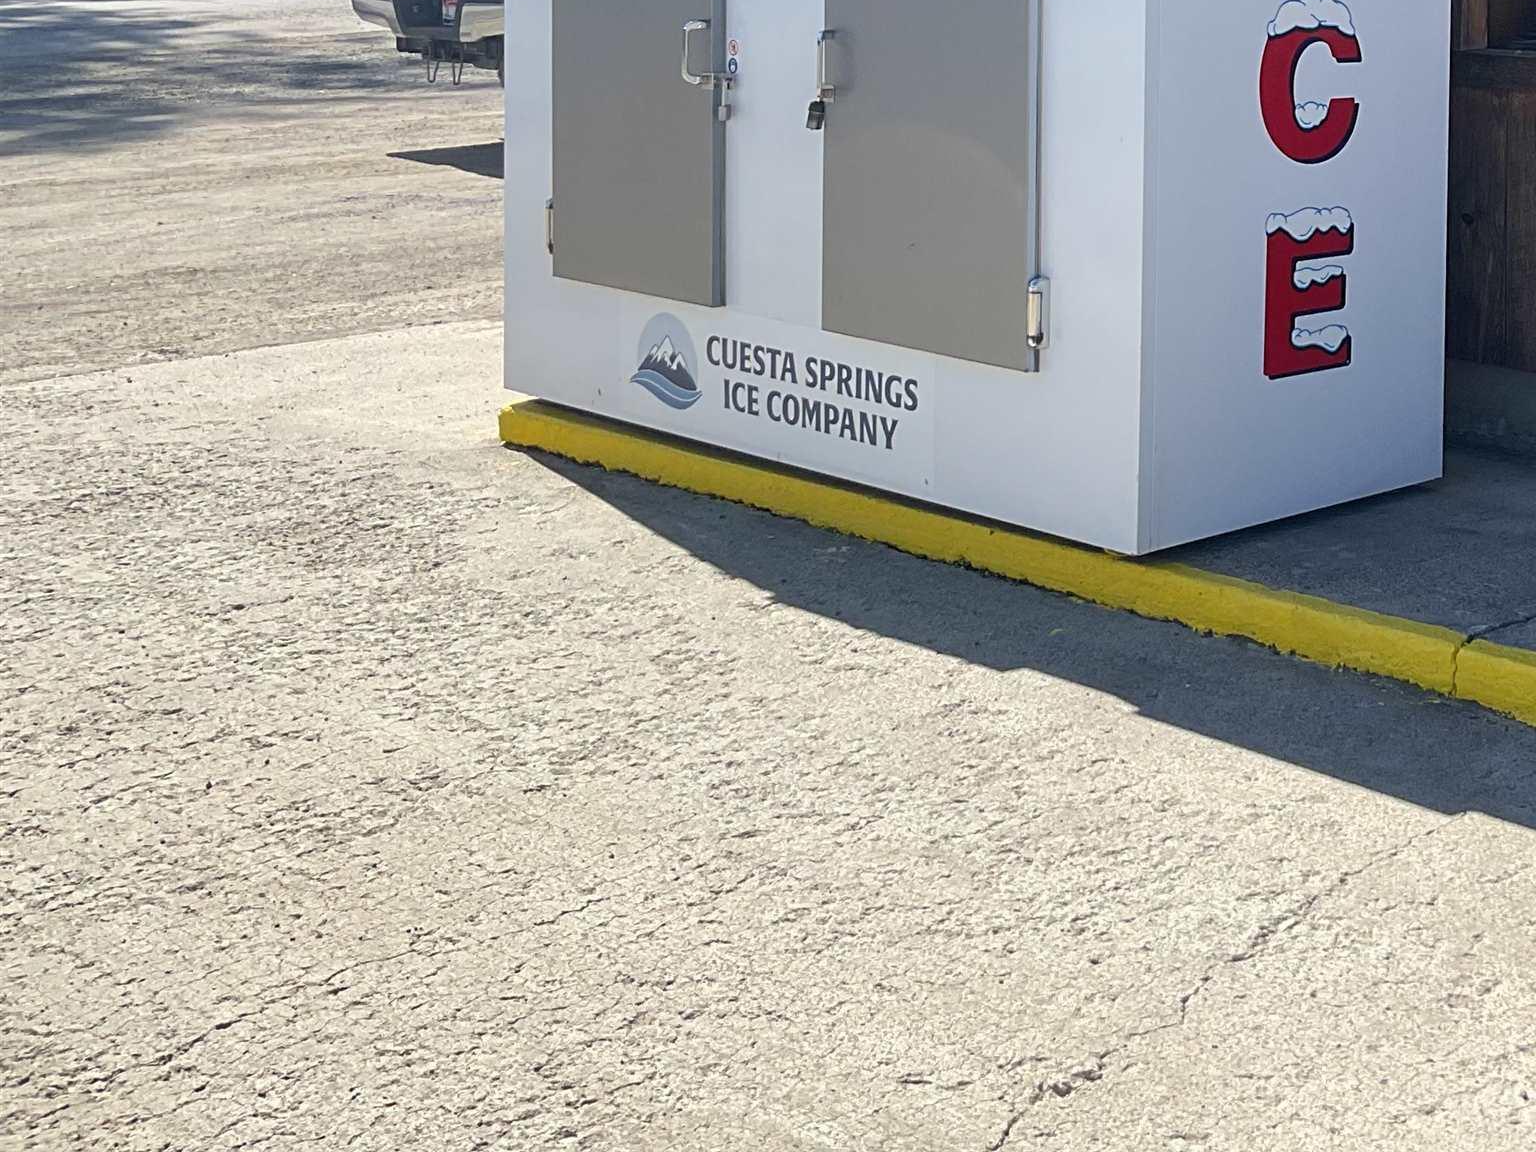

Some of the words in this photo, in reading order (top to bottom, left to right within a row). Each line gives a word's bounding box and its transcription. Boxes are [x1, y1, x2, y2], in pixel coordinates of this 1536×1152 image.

[706, 335, 798, 384] CUESTA
[804, 356, 918, 412] SPRINGS
[723, 379, 760, 417] ICE
[767, 390, 899, 450] COMPANY
